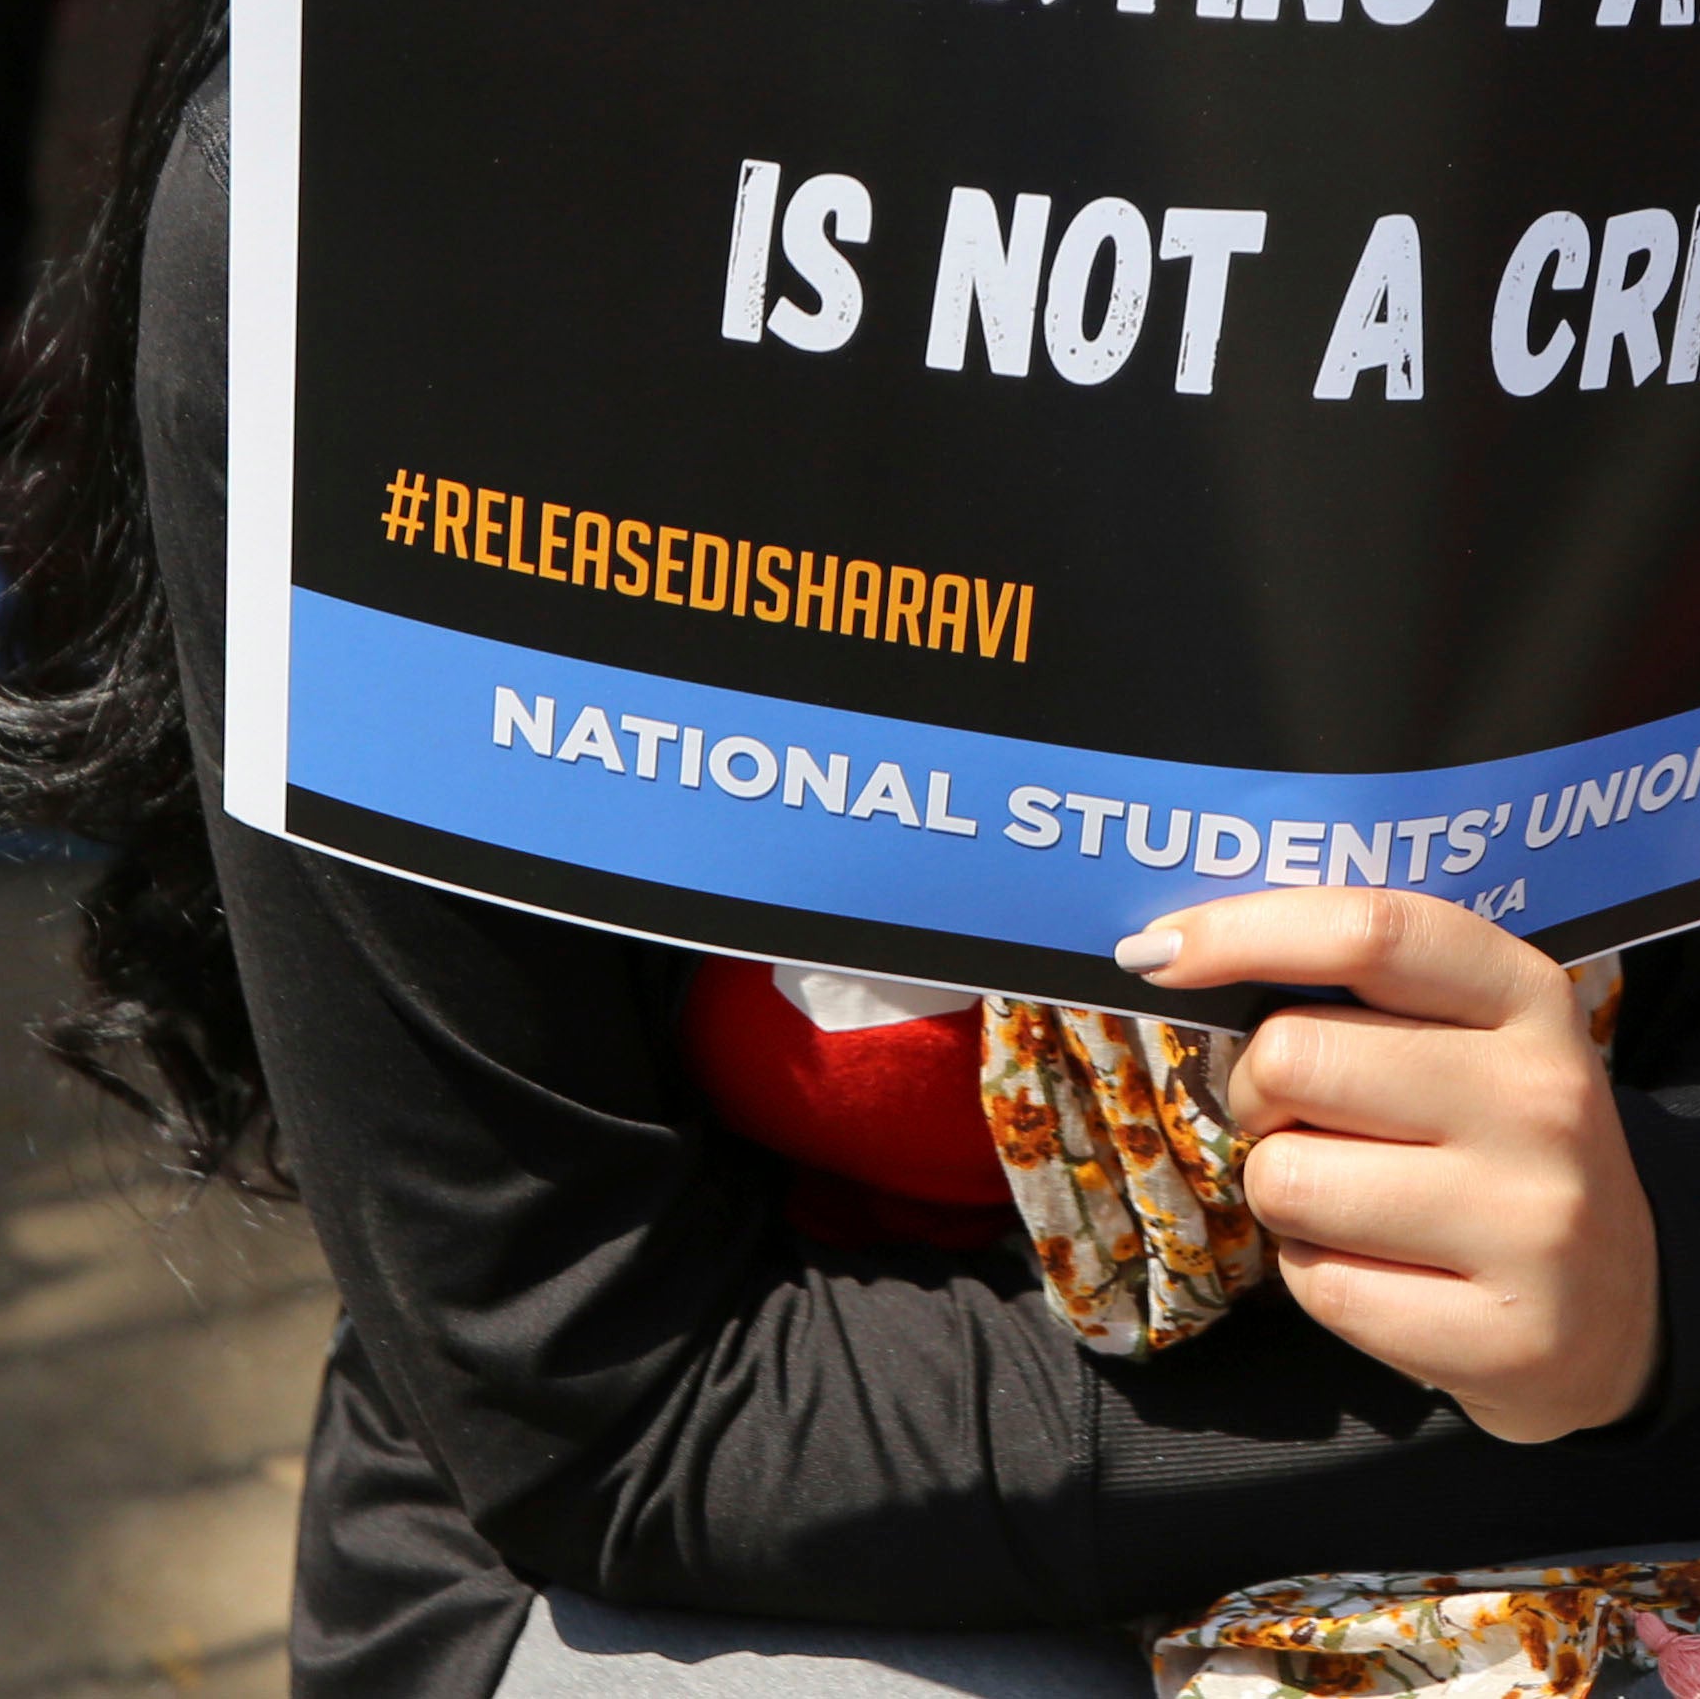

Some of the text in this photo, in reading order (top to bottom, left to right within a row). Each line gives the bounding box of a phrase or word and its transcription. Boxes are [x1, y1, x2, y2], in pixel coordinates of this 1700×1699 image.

[722, 158, 873, 353] IS
[925, 186, 1268, 395] NOT
[1312, 214, 1424, 401] A
[381, 468, 1034, 663] #RELEASEDISHARAVI
[492, 686, 978, 837] NATIONAL
[1003, 786, 1512, 888] STUDENTS'
